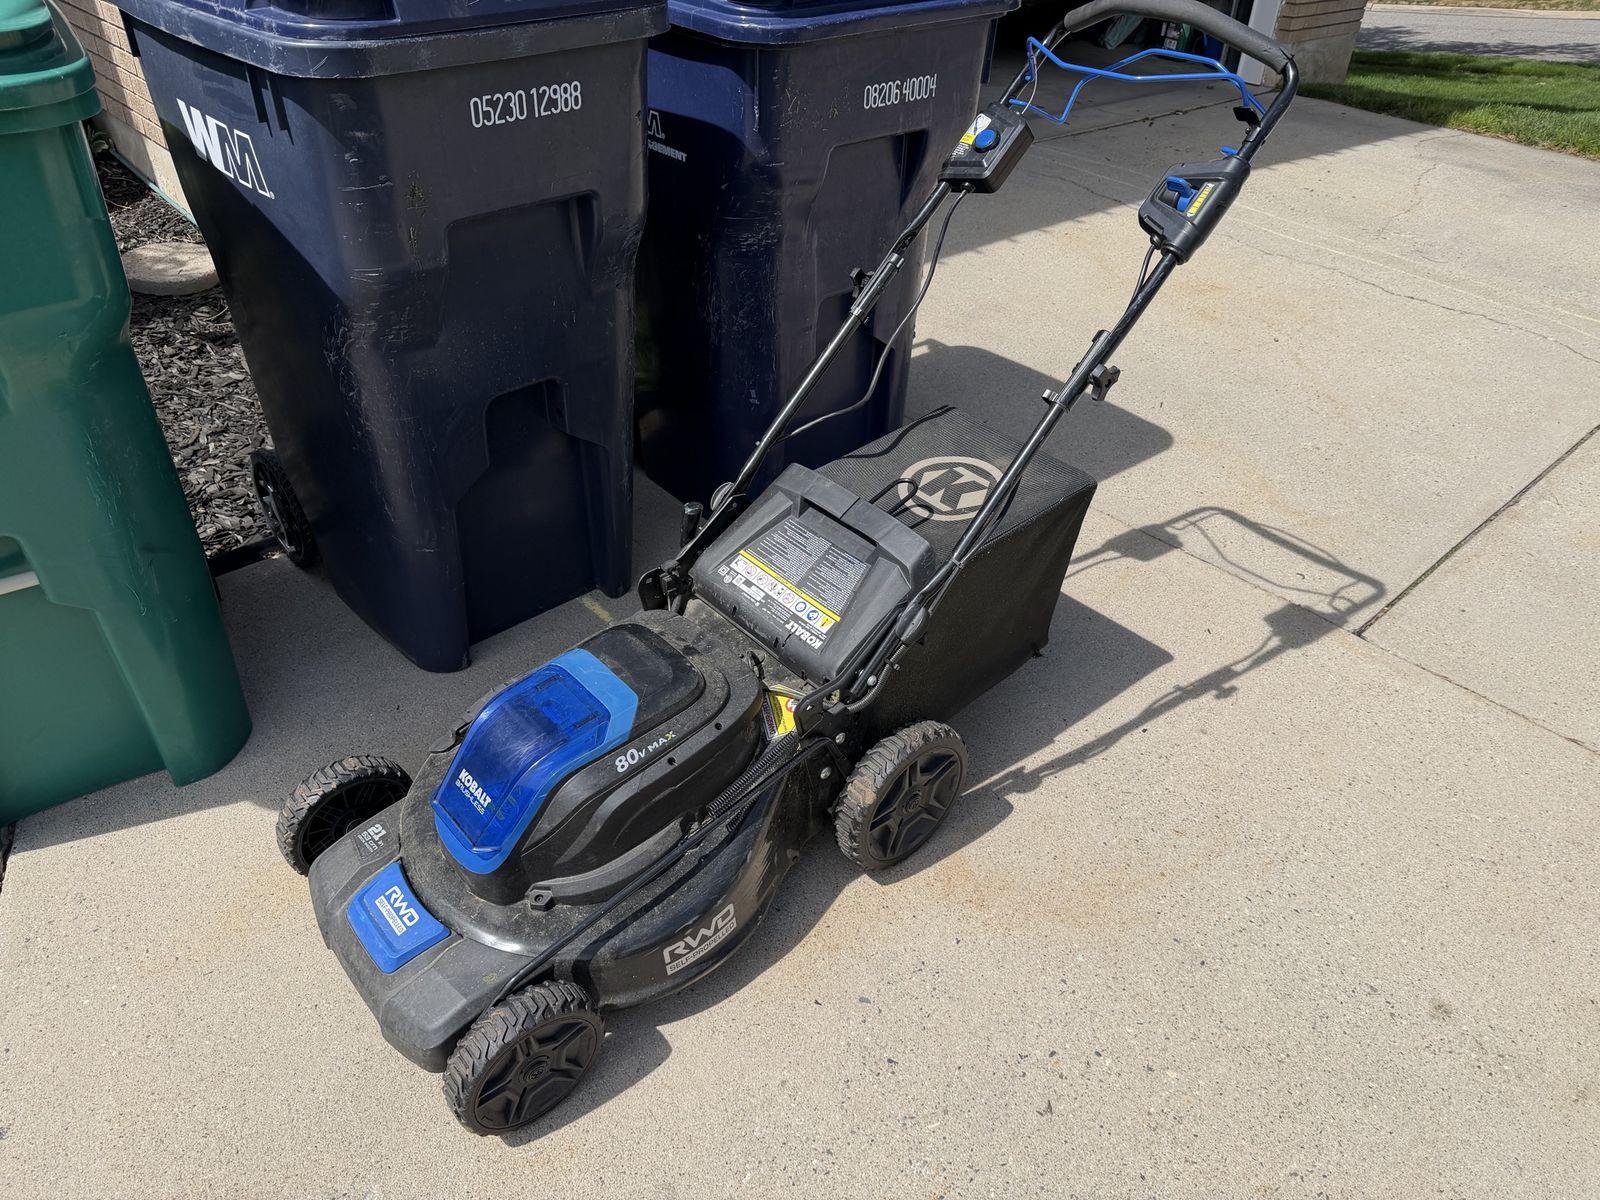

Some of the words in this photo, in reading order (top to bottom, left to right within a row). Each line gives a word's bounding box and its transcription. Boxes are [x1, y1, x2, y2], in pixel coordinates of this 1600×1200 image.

[470, 89, 527, 128] 05230
[530, 80, 582, 118] 12988
[864, 80, 901, 110] 08206
[902, 73, 937, 102] 40004
[176, 97, 271, 199] WM
[785, 619, 823, 650] KOBALT
[647, 730, 677, 752] MAX
[458, 768, 492, 808] KOBALT
[367, 823, 387, 841] 21
[376, 897, 405, 934] SELF-PROPELLED
[384, 885, 420, 927] RWD
[663, 903, 735, 964] RWD
[669, 921, 735, 972] SELF-PROPELLED
